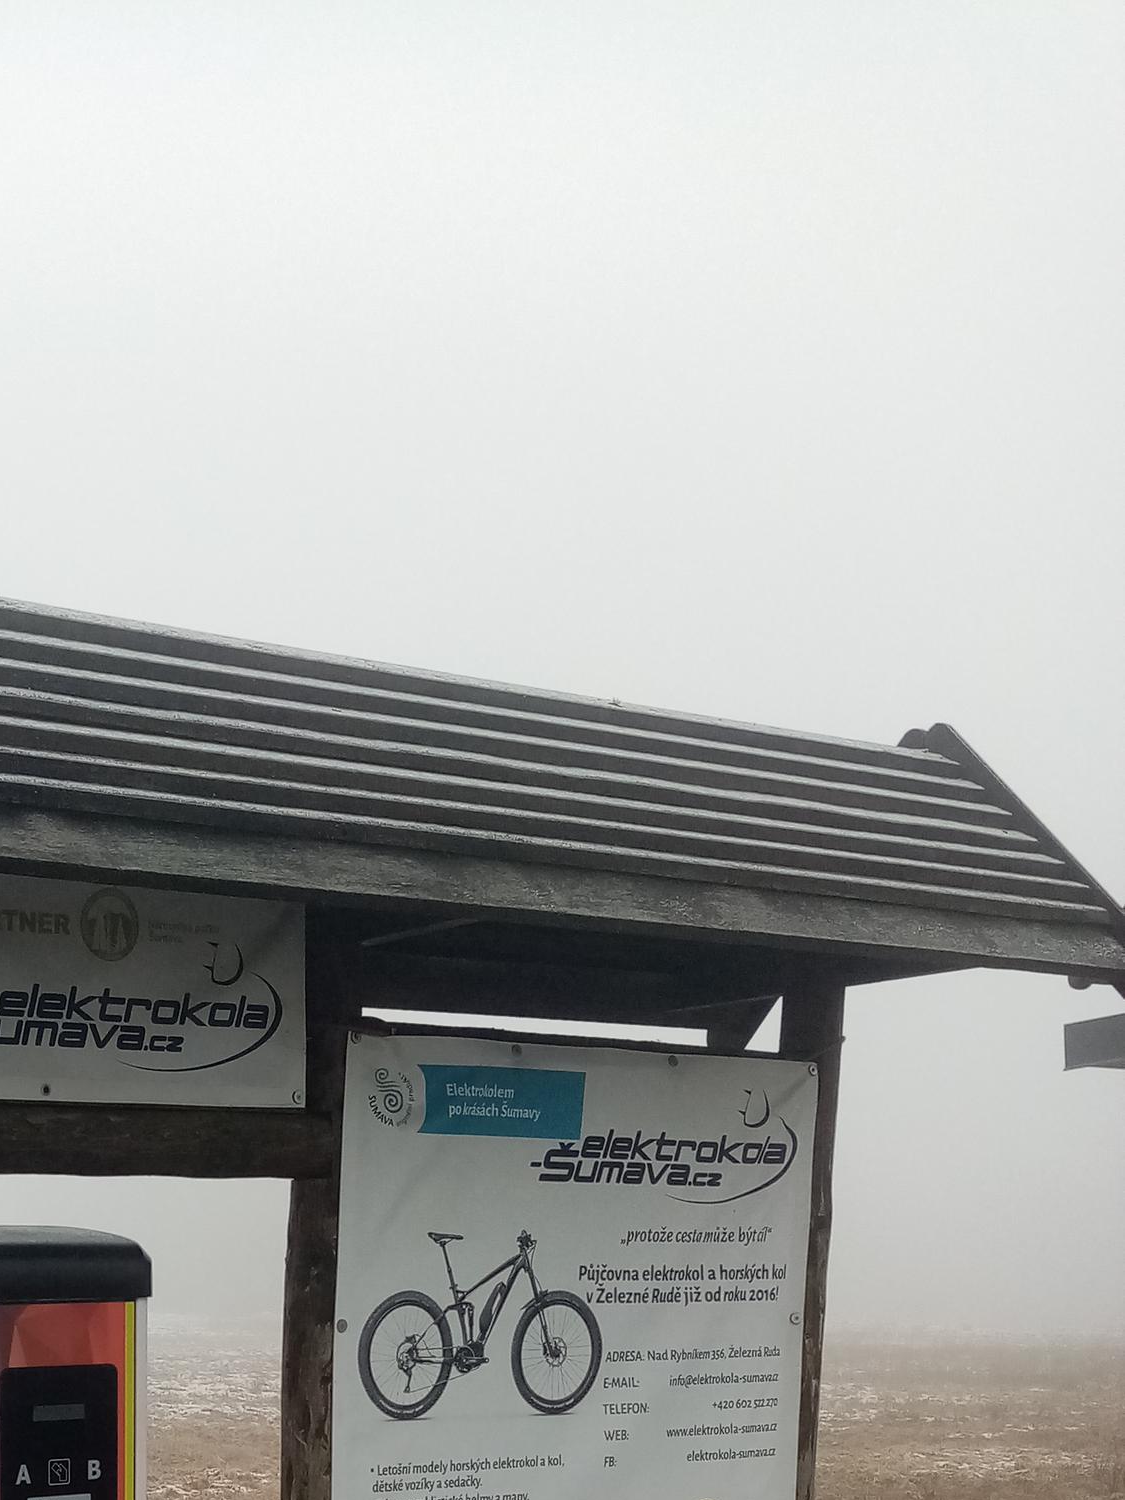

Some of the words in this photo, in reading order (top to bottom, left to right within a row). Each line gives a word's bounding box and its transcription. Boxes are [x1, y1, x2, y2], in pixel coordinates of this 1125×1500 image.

[446, 1083, 515, 1098] Elektrokolem
[448, 1106, 461, 1118] po
[463, 1102, 499, 1117] krásách
[501, 1101, 541, 1122] Šumavy
[581, 1129, 787, 1165] elektrokola
[675, 1229, 703, 1243] cesta
[703, 1226, 735, 1242] může
[578, 1264, 639, 1285] Půjčovna
[642, 1264, 704, 1281] elektrokol
[708, 1269, 716, 1281] a
[719, 1264, 769, 1283] horských
[772, 1264, 787, 1280] kol
[586, 1292, 594, 1303] v
[596, 1284, 649, 1304] Železné
[652, 1287, 681, 1303] Rudě
[684, 1286, 701, 1306] již
[705, 1287, 721, 1302] od
[724, 1287, 746, 1302] roku
[749, 1286, 779, 1302] 2016!
[647, 1349, 669, 1361] Nad
[670, 1349, 710, 1363] Rybníkem
[728, 1345, 762, 1359] Železná
[603, 1402, 650, 1415] TELEFON:
[712, 1399, 734, 1411] +420
[735, 1398, 753, 1409] 602
[604, 1430, 629, 1441] WEB:
[87, 1459, 102, 1481] B
[377, 1462, 412, 1476] Letošní
[412, 1461, 448, 1475] modely
[450, 1458, 491, 1473] horských
[492, 1455, 538, 1469] elektrokol
[539, 1457, 546, 1467] a
[603, 1456, 617, 1468] FB:
[15, 1464, 32, 1486] A
[372, 1479, 404, 1493] dětské
[405, 1477, 435, 1492] vozíky
[436, 1479, 442, 1489] a
[444, 1475, 483, 1489] sedačky.
